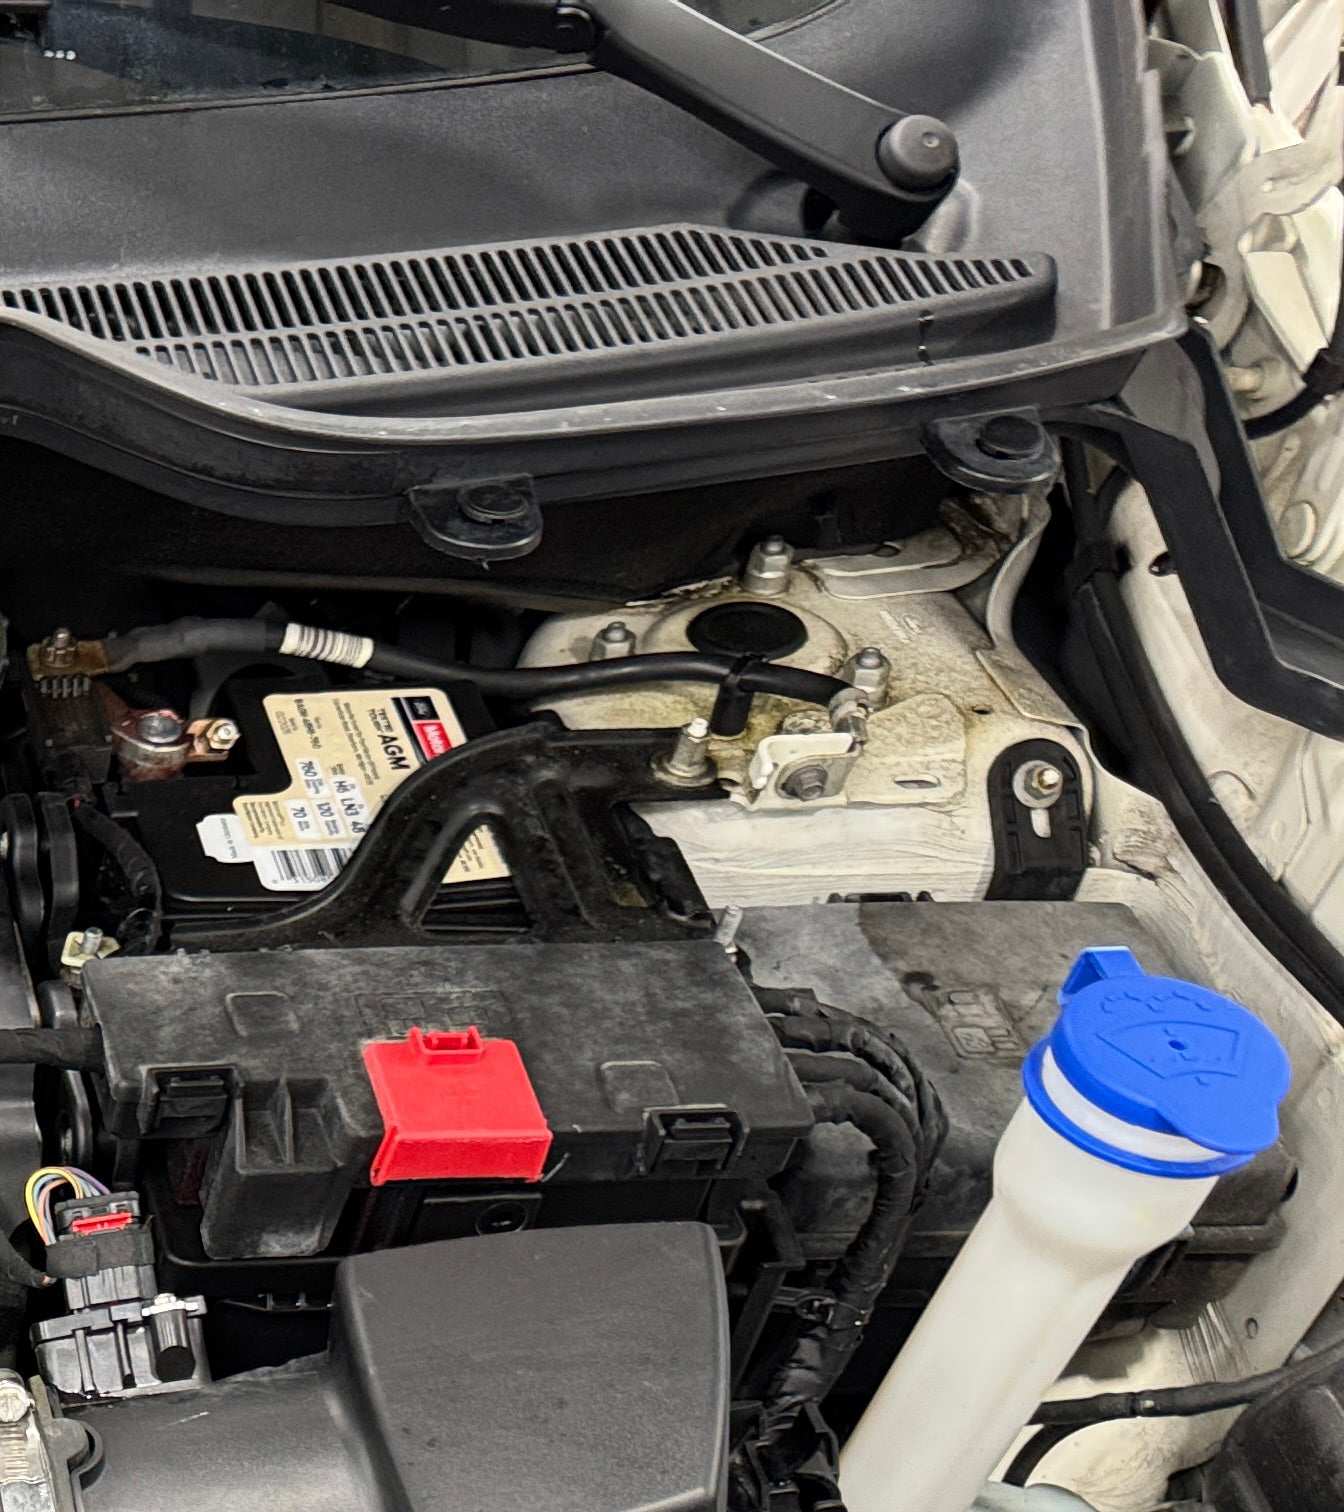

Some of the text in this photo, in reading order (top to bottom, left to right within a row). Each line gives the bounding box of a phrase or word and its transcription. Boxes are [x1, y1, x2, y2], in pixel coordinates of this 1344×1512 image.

[423, 725, 447, 754] Motor
[377, 734, 411, 770] AGM
[290, 806, 307, 818] 70
[316, 802, 334, 817] 120
[340, 797, 360, 816] LN3
